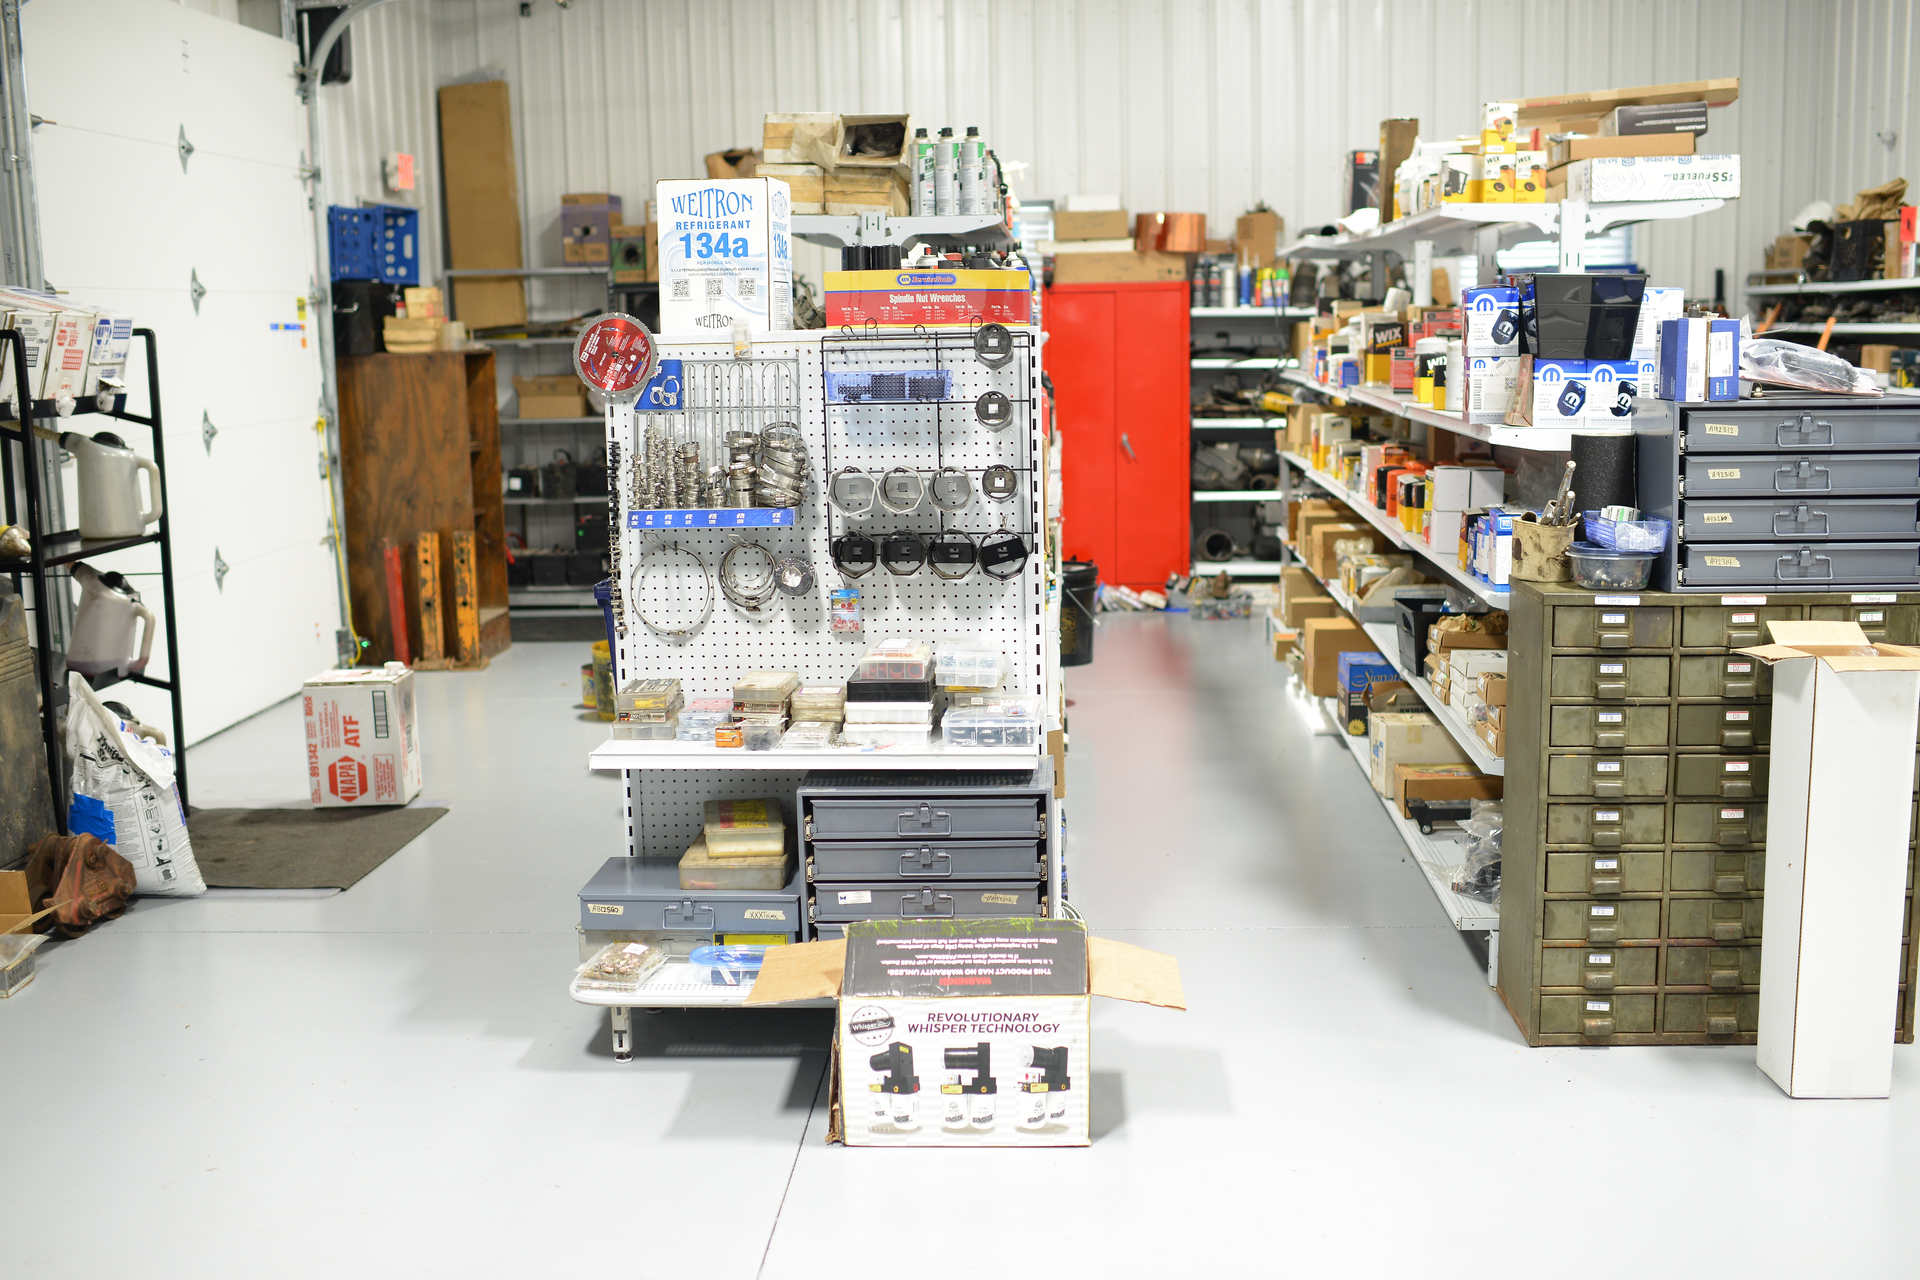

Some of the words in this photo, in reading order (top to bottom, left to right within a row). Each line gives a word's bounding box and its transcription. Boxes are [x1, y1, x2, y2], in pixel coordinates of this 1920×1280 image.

[671, 188, 753, 219] WEITRON
[676, 220, 751, 230] REFRIGERANT
[679, 232, 749, 258] 134a
[774, 233, 788, 260] 134a
[889, 294, 914, 304] Spindle
[916, 294, 928, 303] Nut
[930, 293, 966, 302] Wrenches
[1375, 326, 1402, 344] WIX
[1331, 420, 1344, 428] WIX
[343, 715, 361, 748] ATF
[308, 743, 320, 778] 891342
[339, 762, 358, 795] NAPA
[939, 977, 992, 986] WARNING!
[927, 1013, 1039, 1022] REVOLUTIONARY
[908, 1024, 967, 1033] WHISPER
[970, 1024, 1060, 1033] TECHNOLOGY
